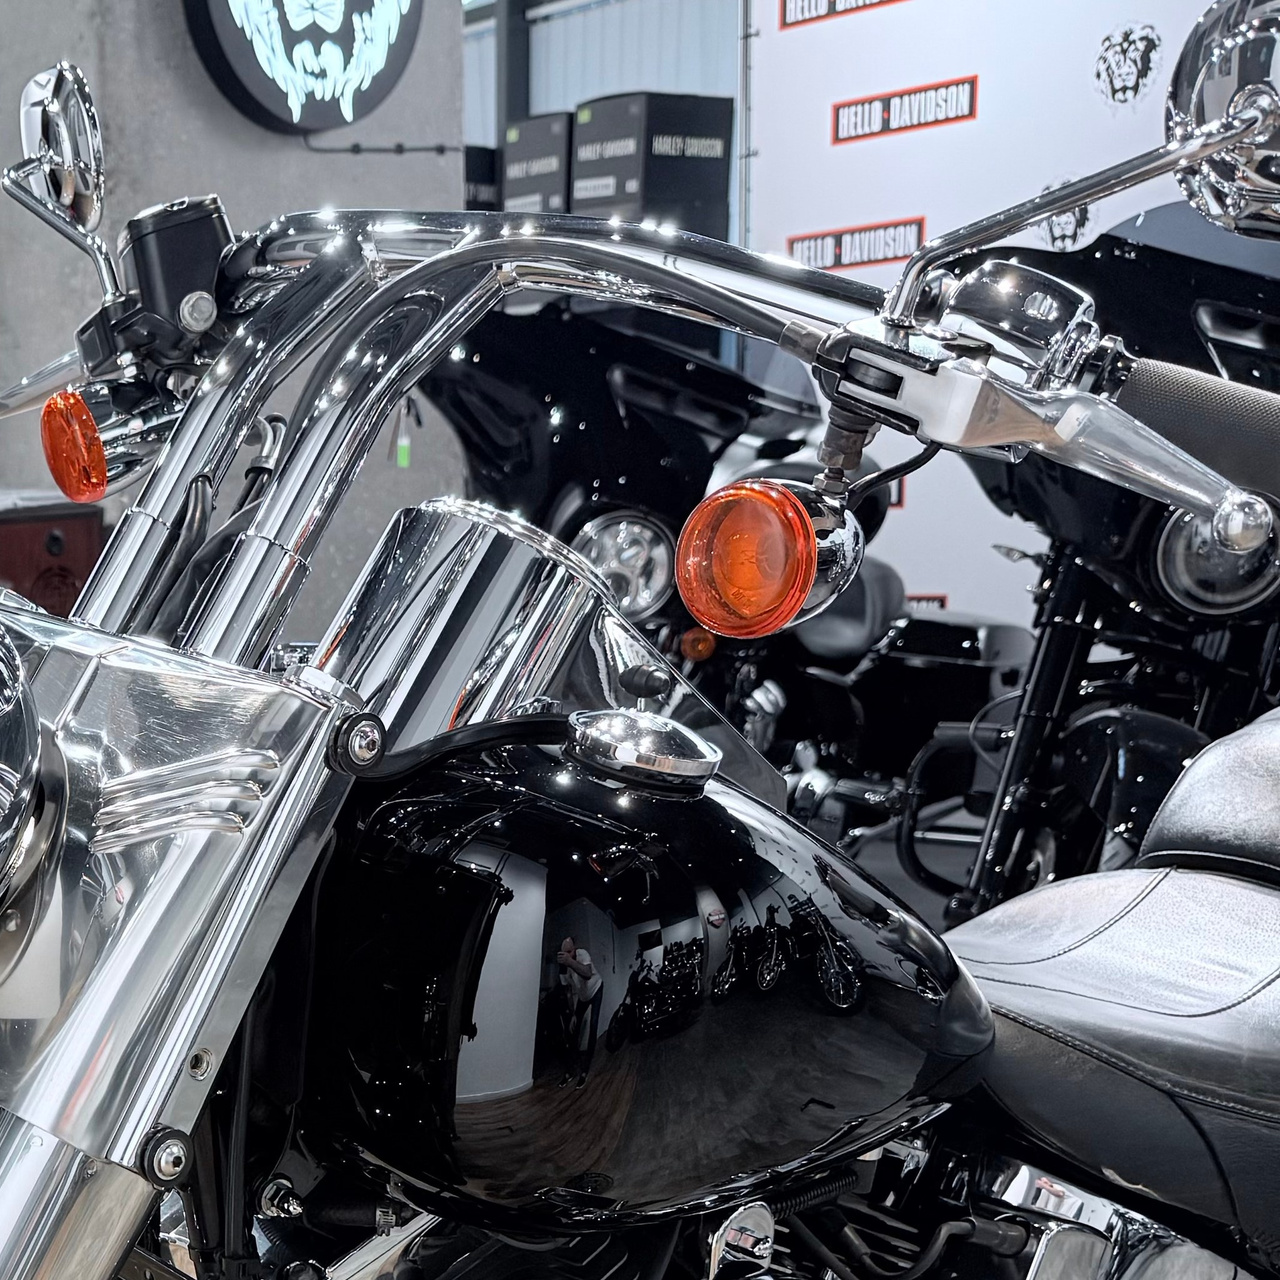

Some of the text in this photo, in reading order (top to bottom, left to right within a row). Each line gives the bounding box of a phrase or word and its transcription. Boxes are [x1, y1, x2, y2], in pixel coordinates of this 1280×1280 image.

[838, 82, 971, 139] HELLO DAVIDSON
[841, 222, 919, 265] DAVIDSON
